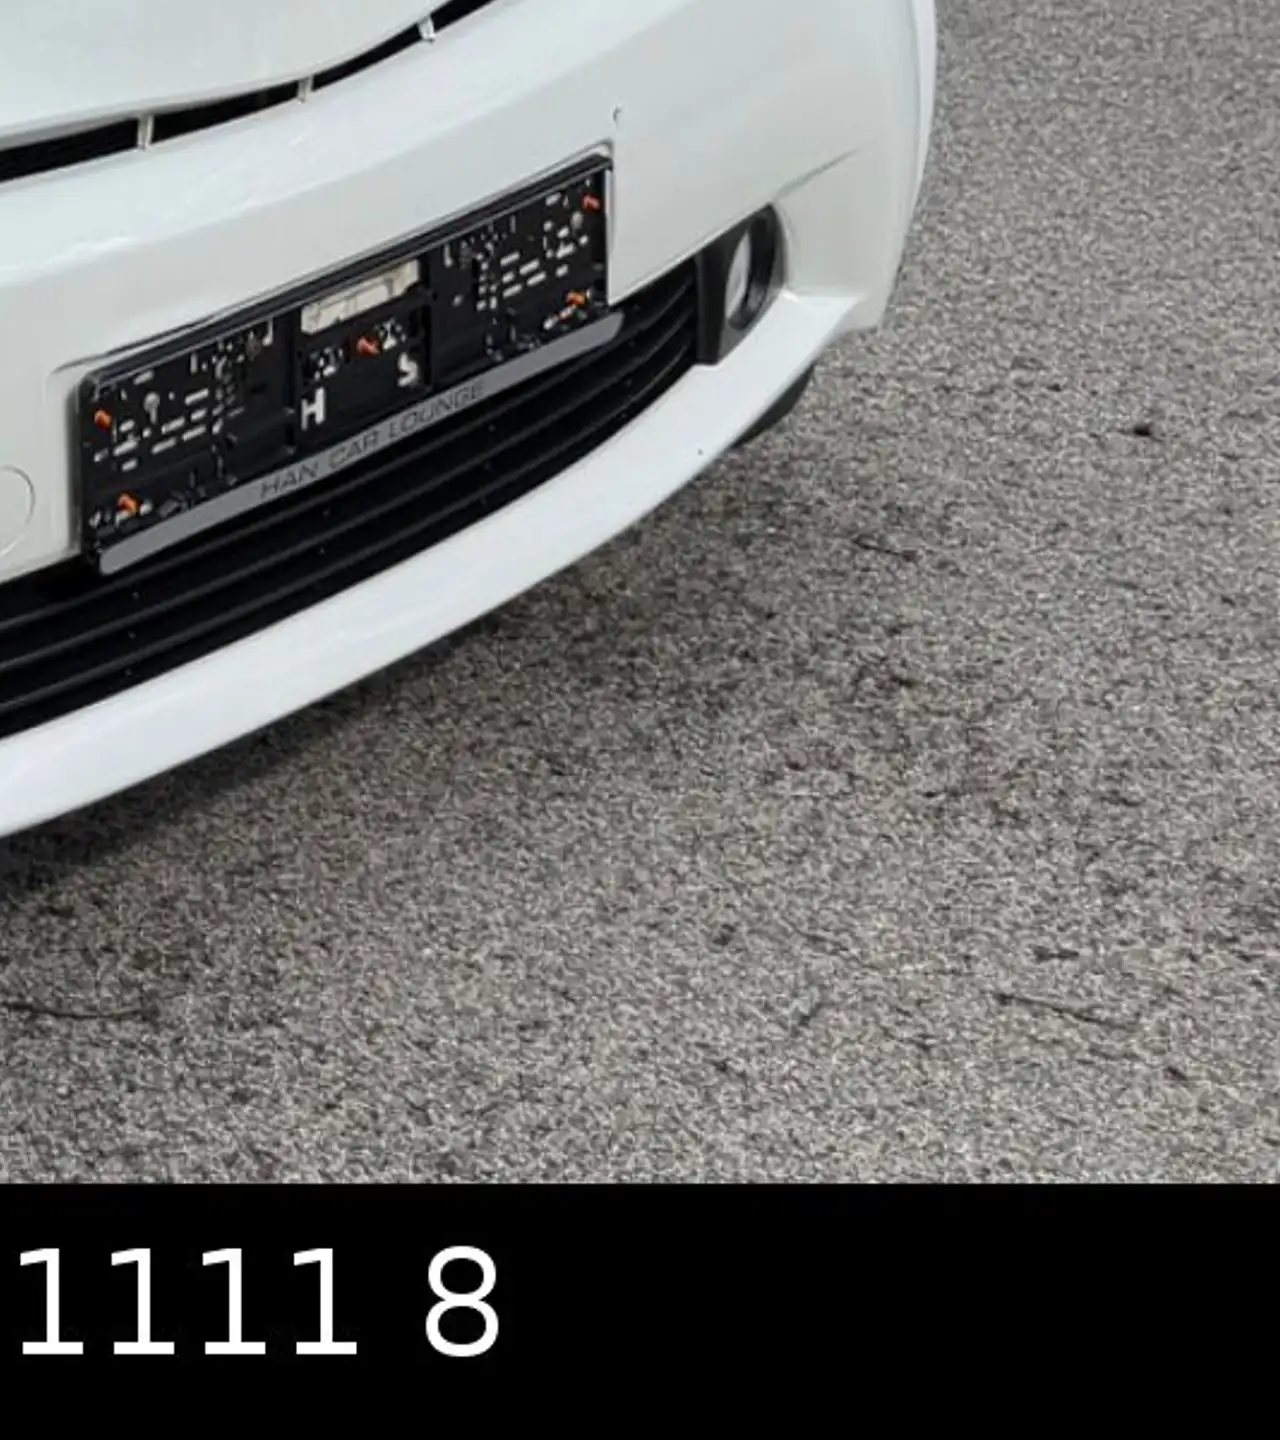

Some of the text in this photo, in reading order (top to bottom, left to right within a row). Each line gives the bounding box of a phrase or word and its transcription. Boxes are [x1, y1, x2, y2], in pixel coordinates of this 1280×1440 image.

[259, 379, 485, 499] HAN CAR LOUNGE
